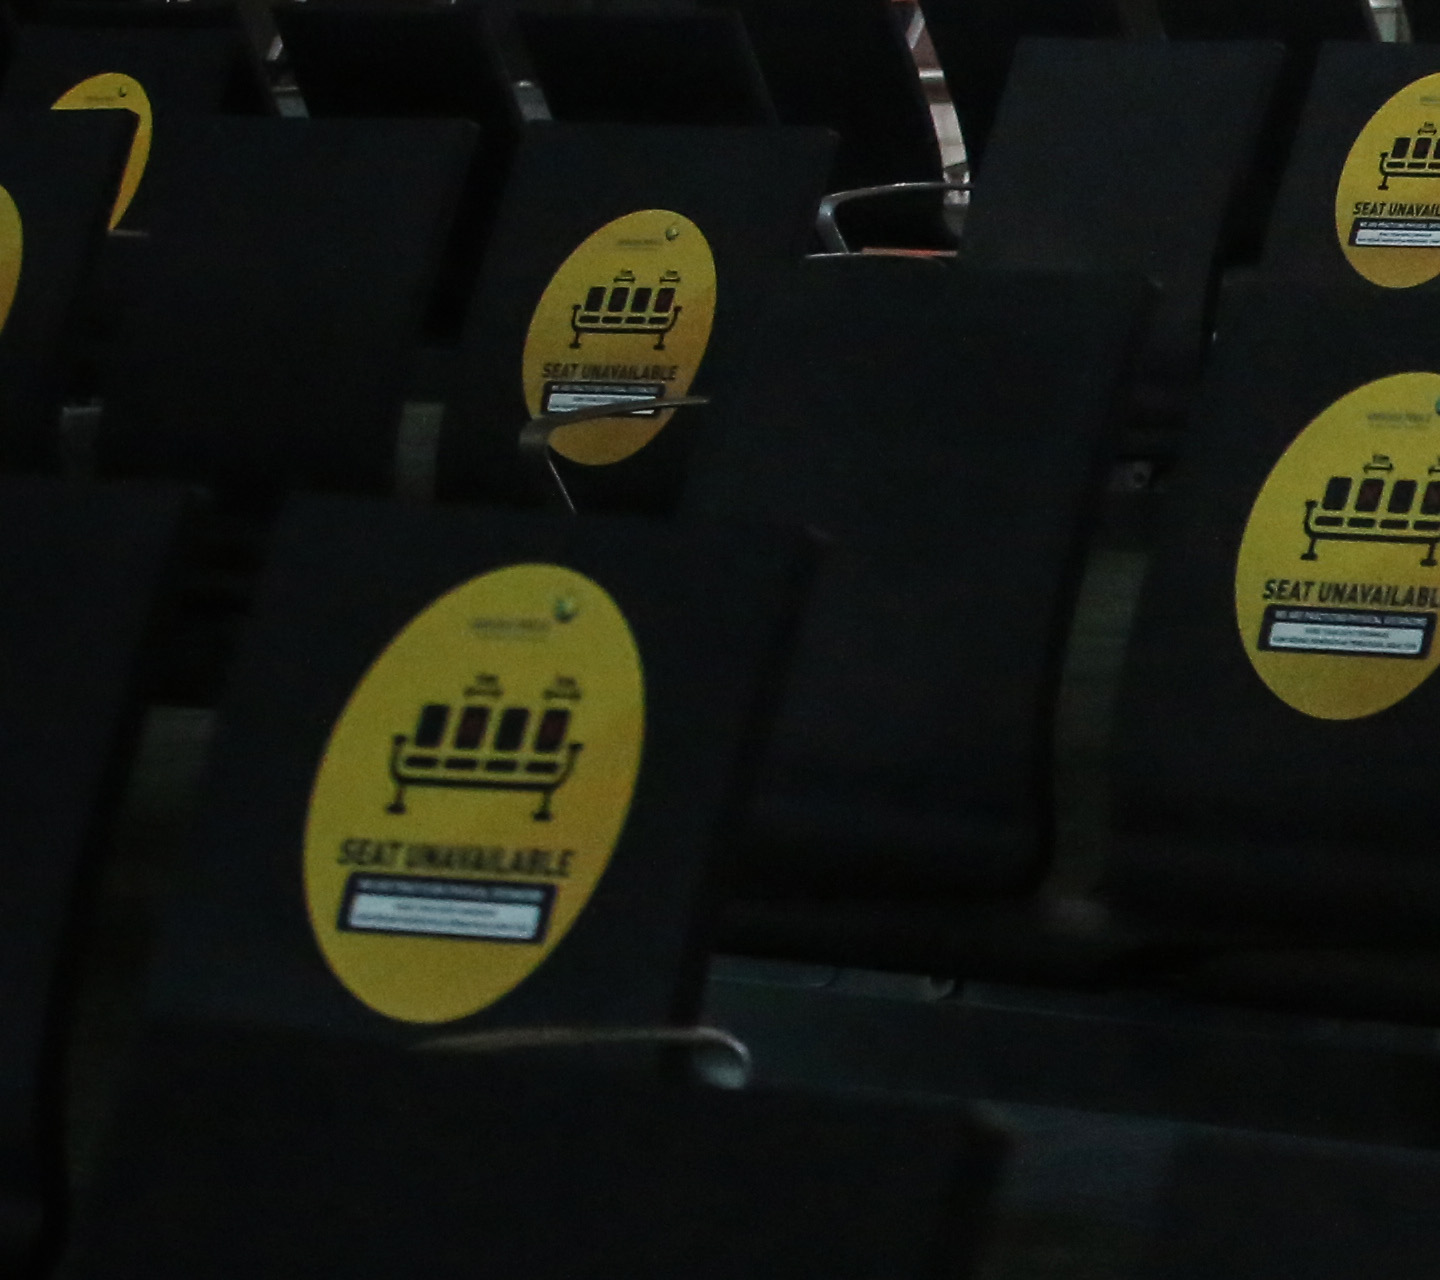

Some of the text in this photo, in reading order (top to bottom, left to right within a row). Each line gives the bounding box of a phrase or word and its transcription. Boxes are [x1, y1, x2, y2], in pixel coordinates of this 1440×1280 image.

[1353, 201, 1387, 216] SEAT
[543, 363, 679, 380] SEAT UNAVAILABLE
[1263, 579, 1316, 601] SEAT
[337, 838, 576, 878] SEAT UNAVAILABLE
